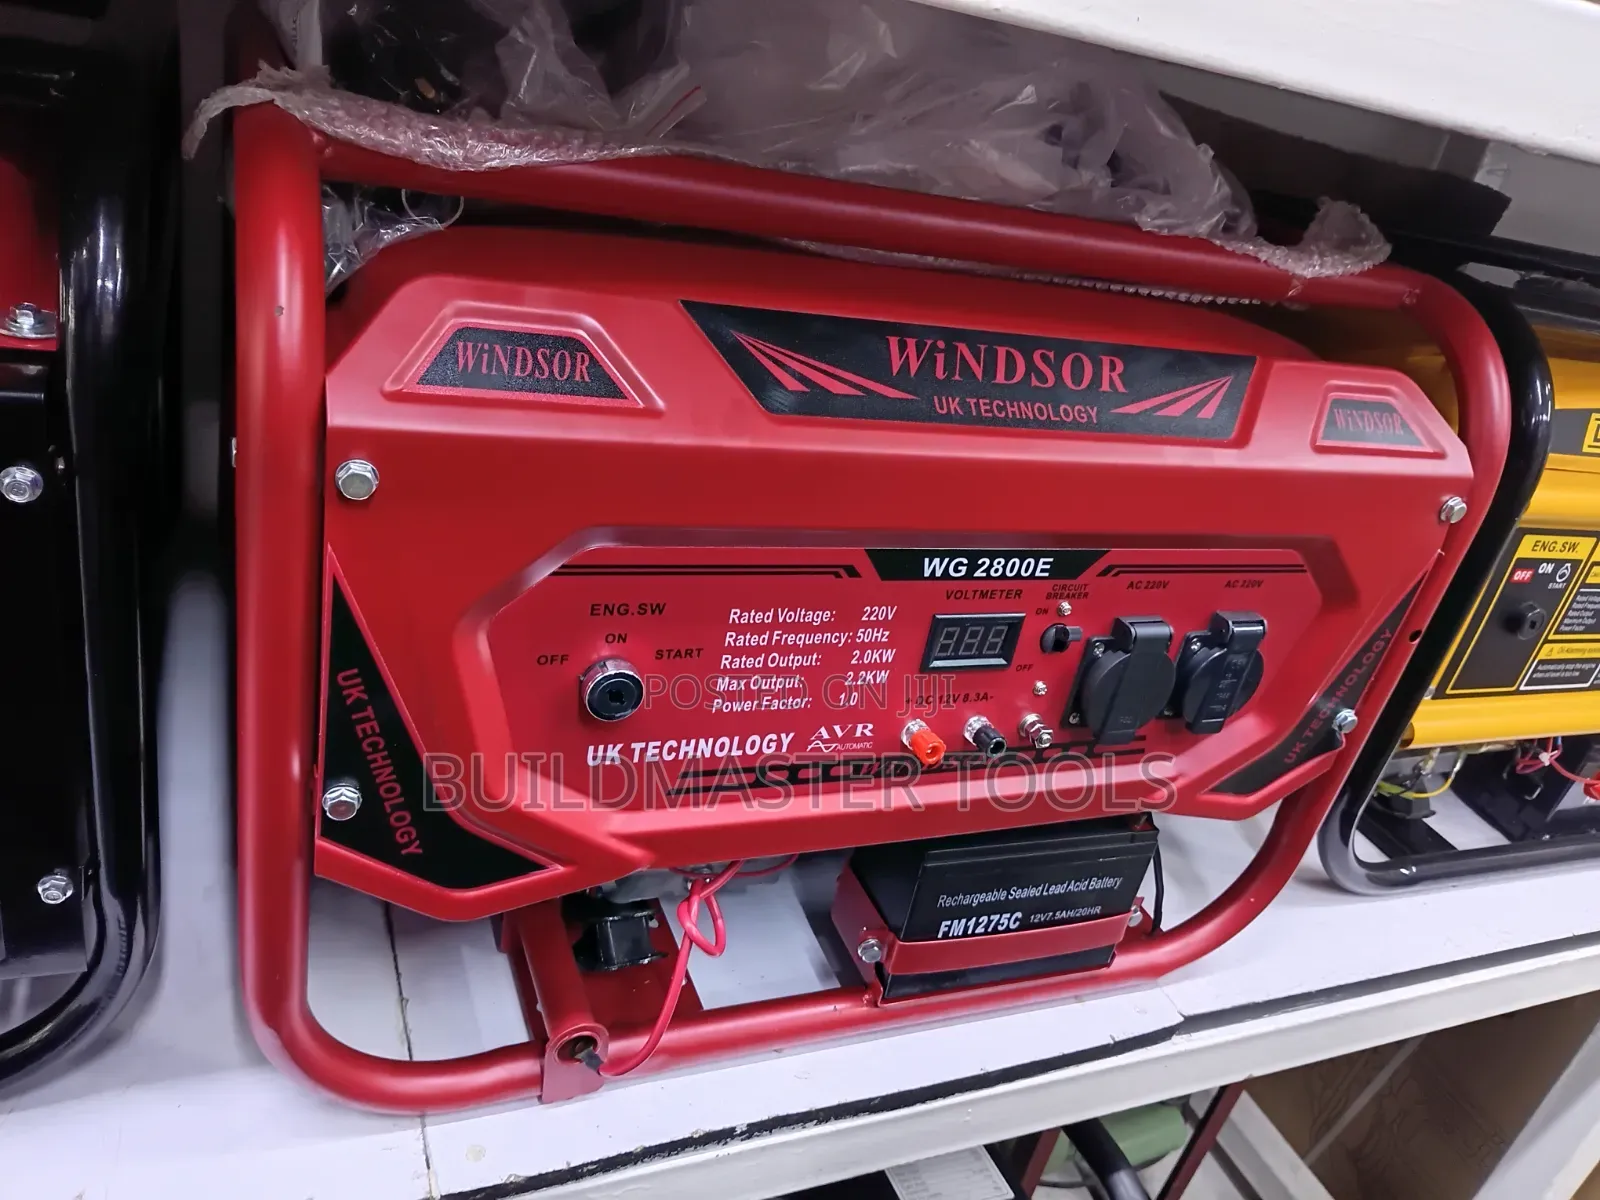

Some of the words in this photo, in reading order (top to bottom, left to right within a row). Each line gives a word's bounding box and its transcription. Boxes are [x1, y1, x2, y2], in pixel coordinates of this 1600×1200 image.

[886, 335, 1128, 393] WiNDSOR
[933, 395, 964, 415] UK
[966, 397, 1098, 424] TECHNOLOGY
[1531, 540, 1580, 553] ENG.SW.
[923, 557, 968, 578] WG
[973, 557, 1053, 578] 2800E
[1513, 570, 1533, 580] OFF
[1538, 563, 1555, 573] ON
[1052, 584, 1089, 592] CIRCUIT
[1126, 580, 1143, 590] AC
[1144, 580, 1170, 590] 220V
[1224, 579, 1239, 589] AC
[1240, 579, 1264, 589] 220V
[946, 589, 1023, 600] VOLTMETER
[1045, 592, 1089, 600] BREAKER
[589, 602, 667, 616] ENG.SW
[729, 608, 773, 624] Rated
[778, 607, 836, 625] Voltage:
[861, 606, 897, 621] 220V
[1035, 607, 1048, 615] ON
[605, 633, 628, 644] ON
[725, 631, 769, 647] Rated
[772, 630, 853, 648] Frequency:
[856, 628, 890, 643] 50Hz
[536, 654, 569, 666] OFF
[655, 648, 704, 660] START
[720, 654, 764, 669] Rated
[767, 653, 822, 670] Output:
[851, 649, 896, 664] 2.0KW
[1016, 664, 1033, 672] OFF
[337, 668, 369, 706] UK
[716, 676, 745, 691] Max
[750, 675, 804, 692] Output:
[844, 670, 889, 686] 2.2KW
[712, 698, 758, 713] Power
[762, 695, 812, 711] Factor:
[839, 691, 858, 706] 1.0
[1284, 742, 1307, 764] UK
[1303, 628, 1393, 739] TECHNOLOGY
[810, 723, 874, 740] AVR
[586, 744, 624, 767] UK
[631, 732, 795, 764] TECHNOLOGY
[836, 741, 874, 751] AUTOMATIC
[351, 705, 423, 855] TECHNOLOGY
[937, 887, 1007, 908] Rechargeable
[1008, 885, 1042, 900] Sealed
[1043, 881, 1066, 897] Lead
[1067, 878, 1089, 893] Acid
[1089, 876, 1123, 891] Battery
[1029, 905, 1101, 923] 12V7.5AH/20HR
[937, 911, 1022, 939] FM1275C
